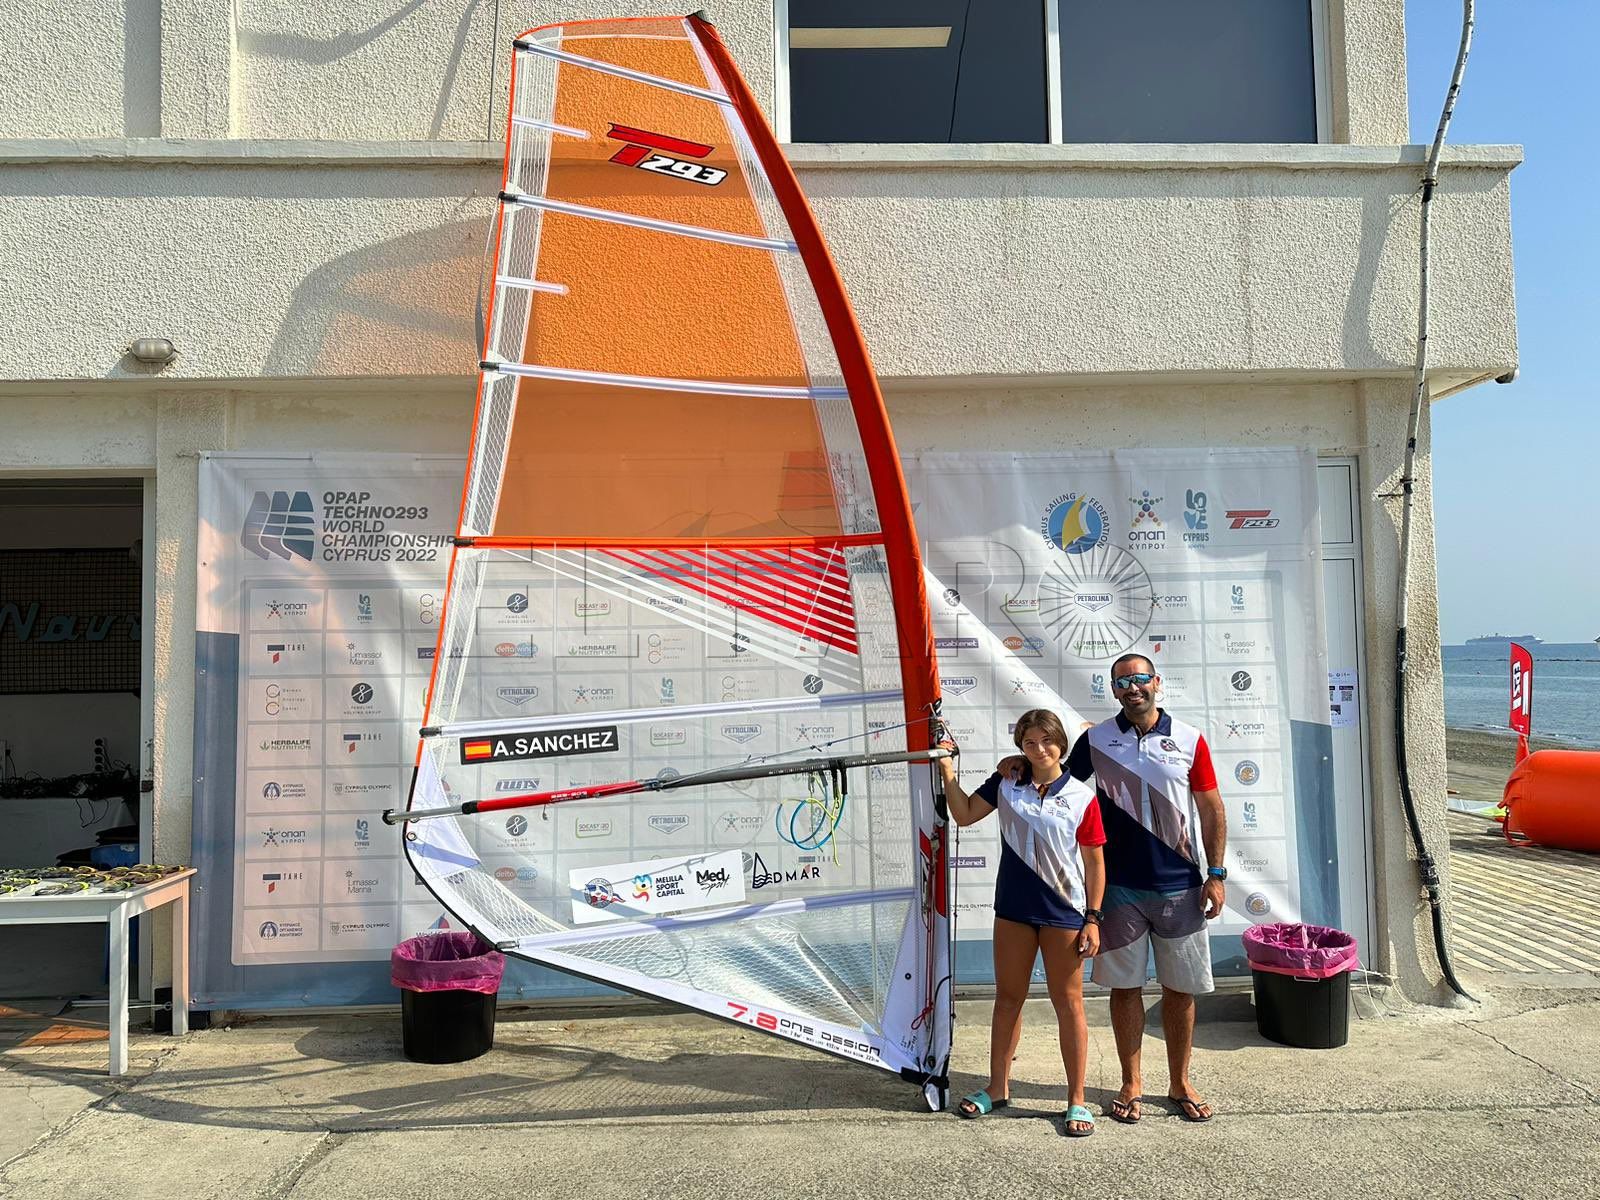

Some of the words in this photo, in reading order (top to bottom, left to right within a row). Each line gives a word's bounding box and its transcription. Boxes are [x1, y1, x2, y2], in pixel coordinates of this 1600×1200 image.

[607, 122, 728, 186] T293
[323, 491, 371, 504] OPAP
[1045, 492, 1076, 514] SAILING
[323, 506, 428, 519] TECHNO293
[1088, 497, 1110, 549] FEDERATION
[1225, 510, 1281, 529] T293
[323, 520, 384, 533] WORLD
[1041, 516, 1055, 550] CYPRUS
[1183, 532, 1209, 542] CYPRUS
[323, 548, 391, 561] CYPRUS
[395, 548, 437, 561] 2022
[500, 688, 535, 696] PETROLINA
[724, 726, 758, 734] PETROLINA
[493, 731, 614, 757] A.SANCHEZ
[651, 816, 686, 825] PETROLINA
[348, 878, 378, 886] Limassol
[655, 874, 684, 884] MELILLA
[696, 868, 725, 884] Med
[656, 882, 679, 891] SPORT
[656, 889, 685, 898] CAPITAL
[727, 1002, 778, 1030] 7.8
